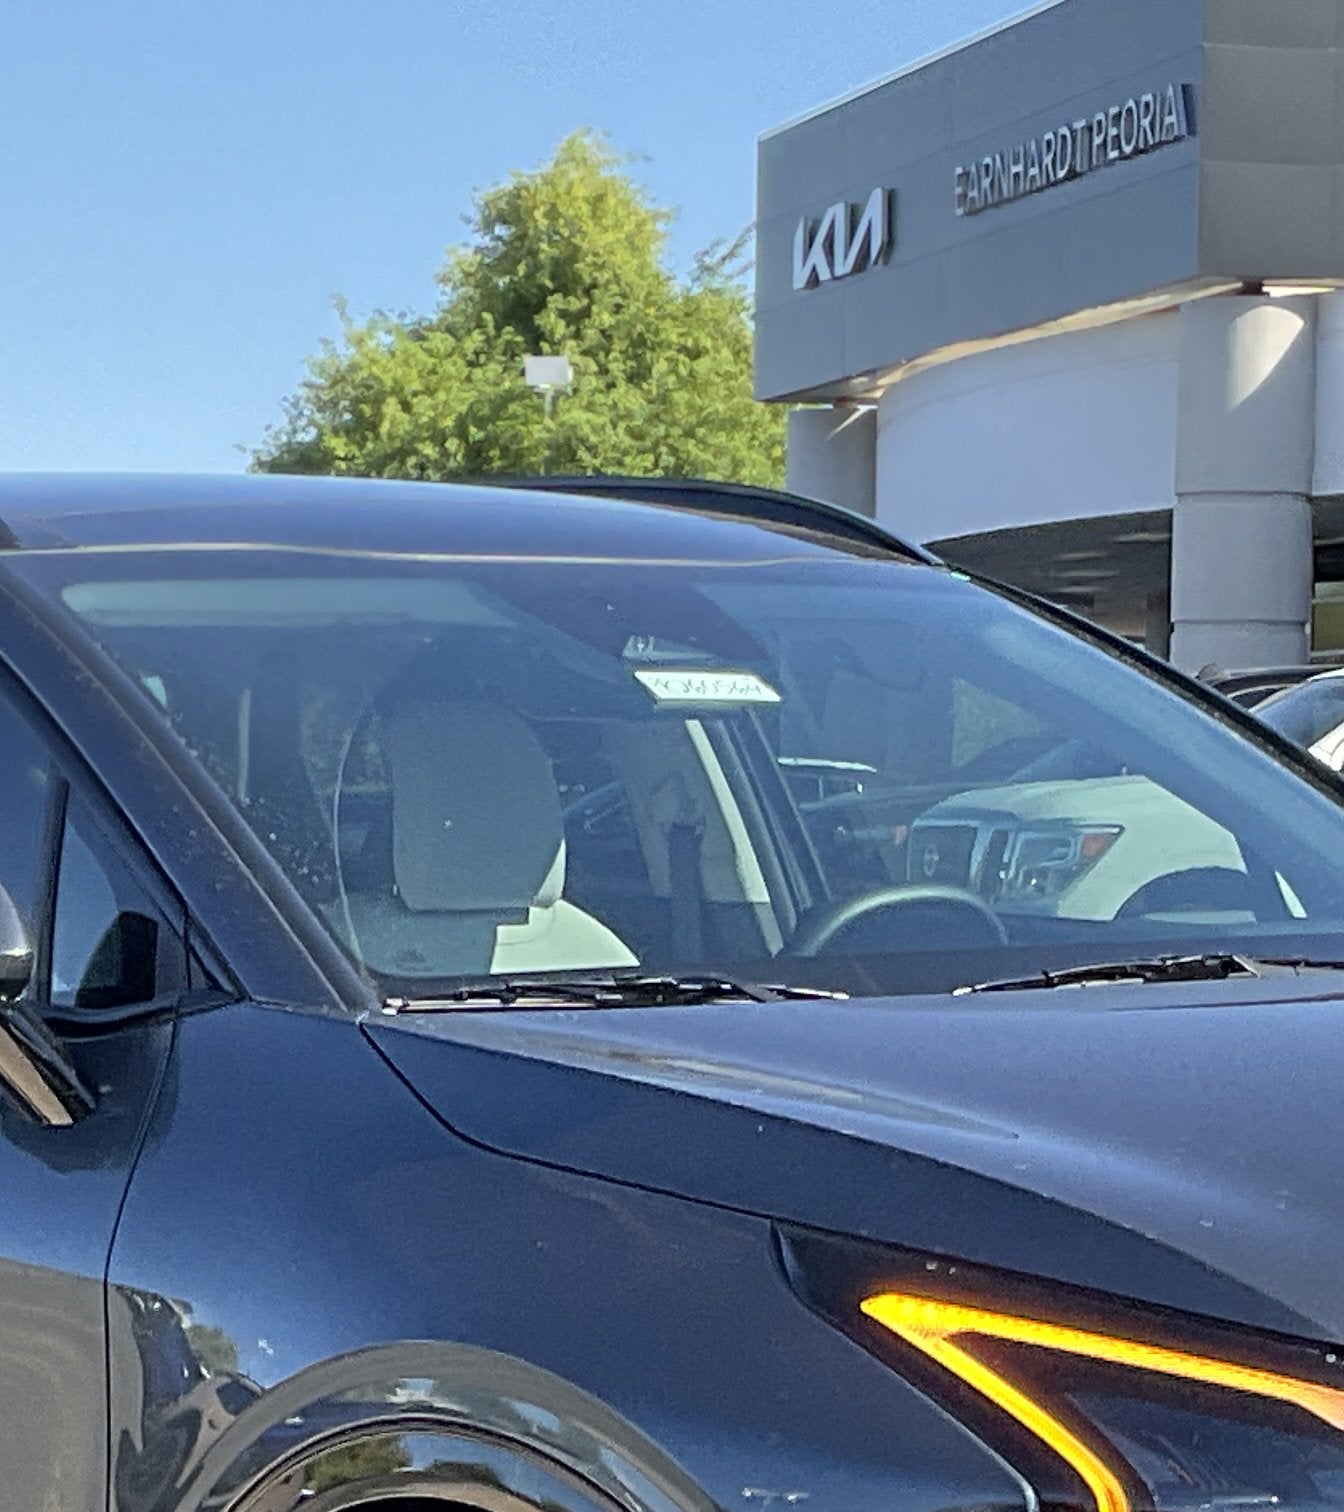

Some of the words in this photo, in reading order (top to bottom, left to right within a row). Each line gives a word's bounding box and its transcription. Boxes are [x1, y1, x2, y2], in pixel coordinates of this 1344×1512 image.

[955, 118, 1087, 217] EARNHARDT
[1091, 82, 1180, 166] PEORIA
[792, 186, 887, 290] KIA
